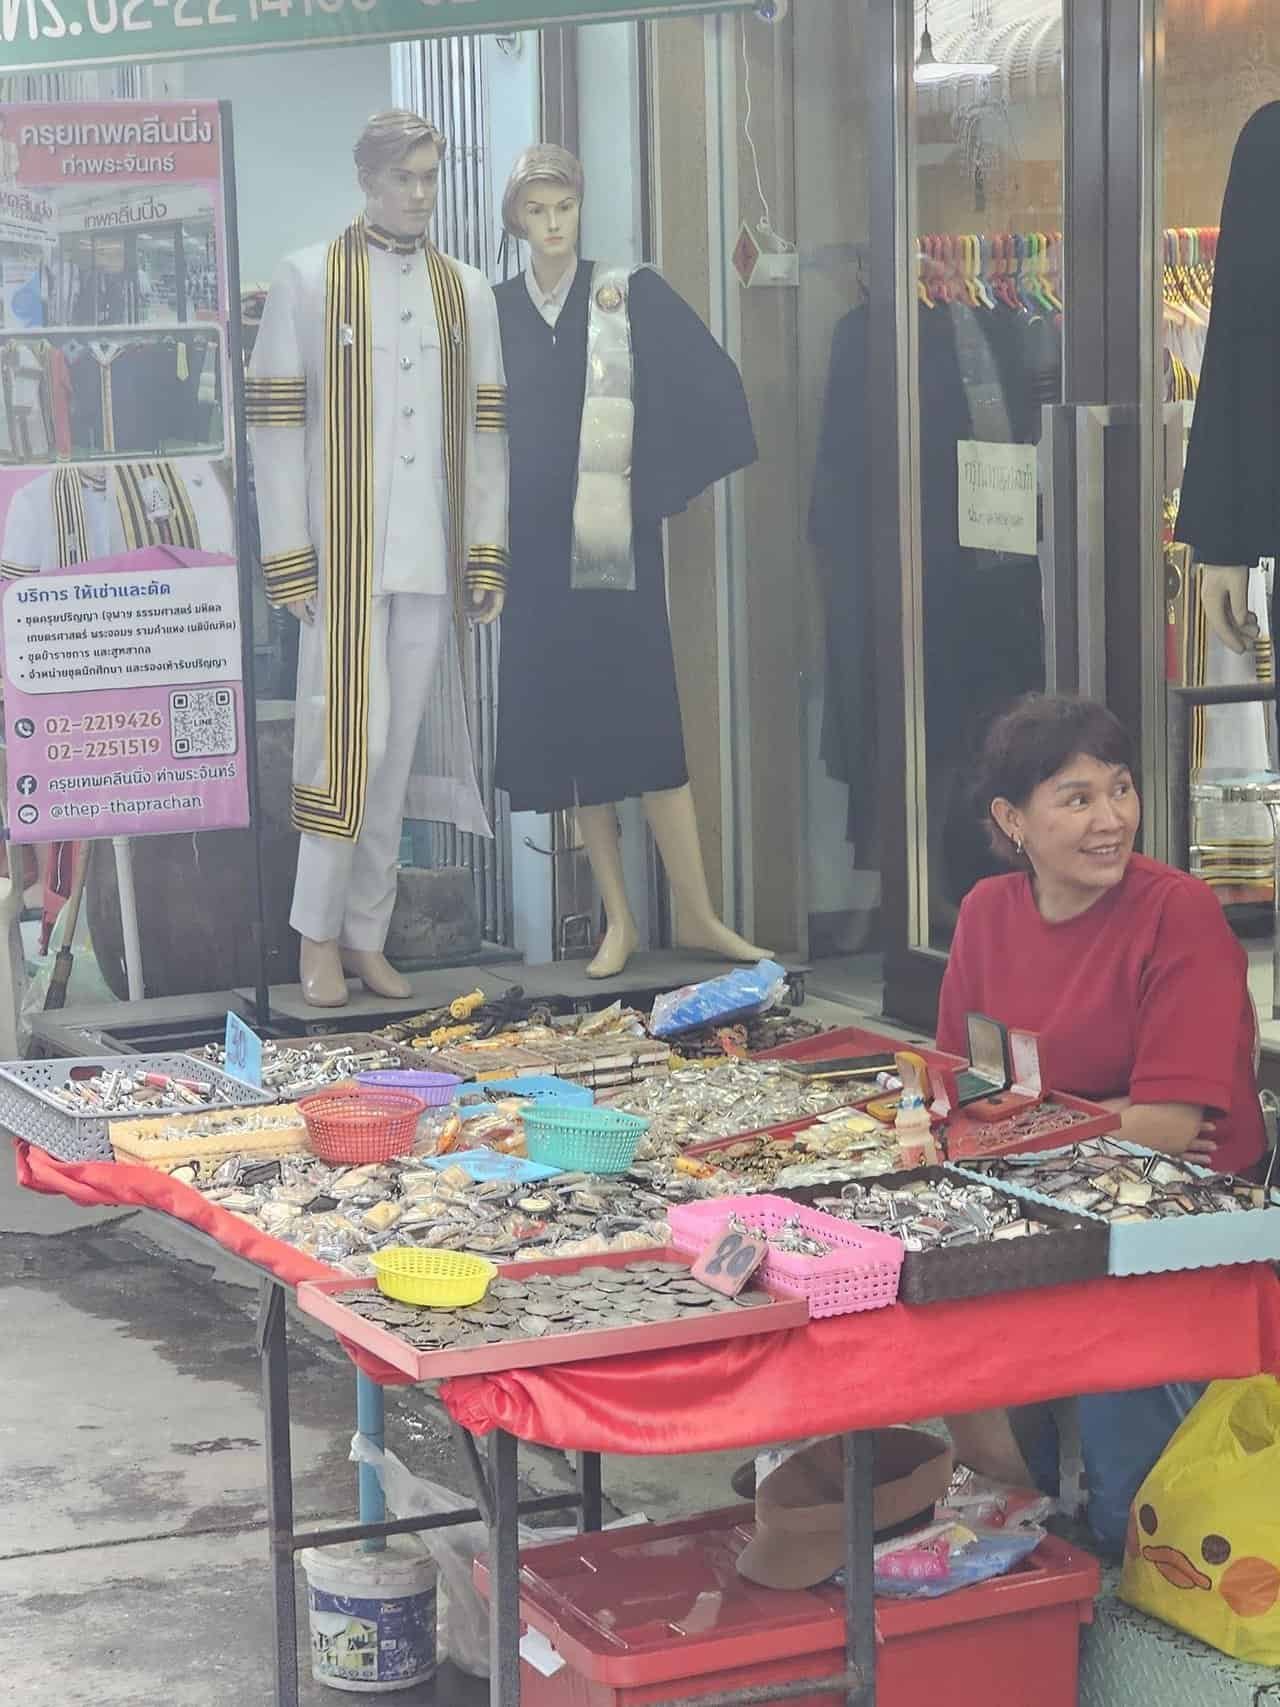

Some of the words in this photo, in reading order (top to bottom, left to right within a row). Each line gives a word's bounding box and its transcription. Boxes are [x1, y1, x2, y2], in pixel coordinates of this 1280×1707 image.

[20, 108, 213, 154] ครุยเทพคลีนนิ่ง
[62, 152, 176, 175] ท่าพระจันทร์
[17, 585, 68, 603] บริการ
[46, 712, 162, 734] 02-2219426
[47, 739, 160, 760] 02-2251519
[49, 769, 151, 792] ครุยเทพคลีนนิ่ง
[157, 764, 237, 784] ท่าพระจันทร์
[50, 795, 202, 818] @thep-thaprachan
[705, 1234, 756, 1277] 20
